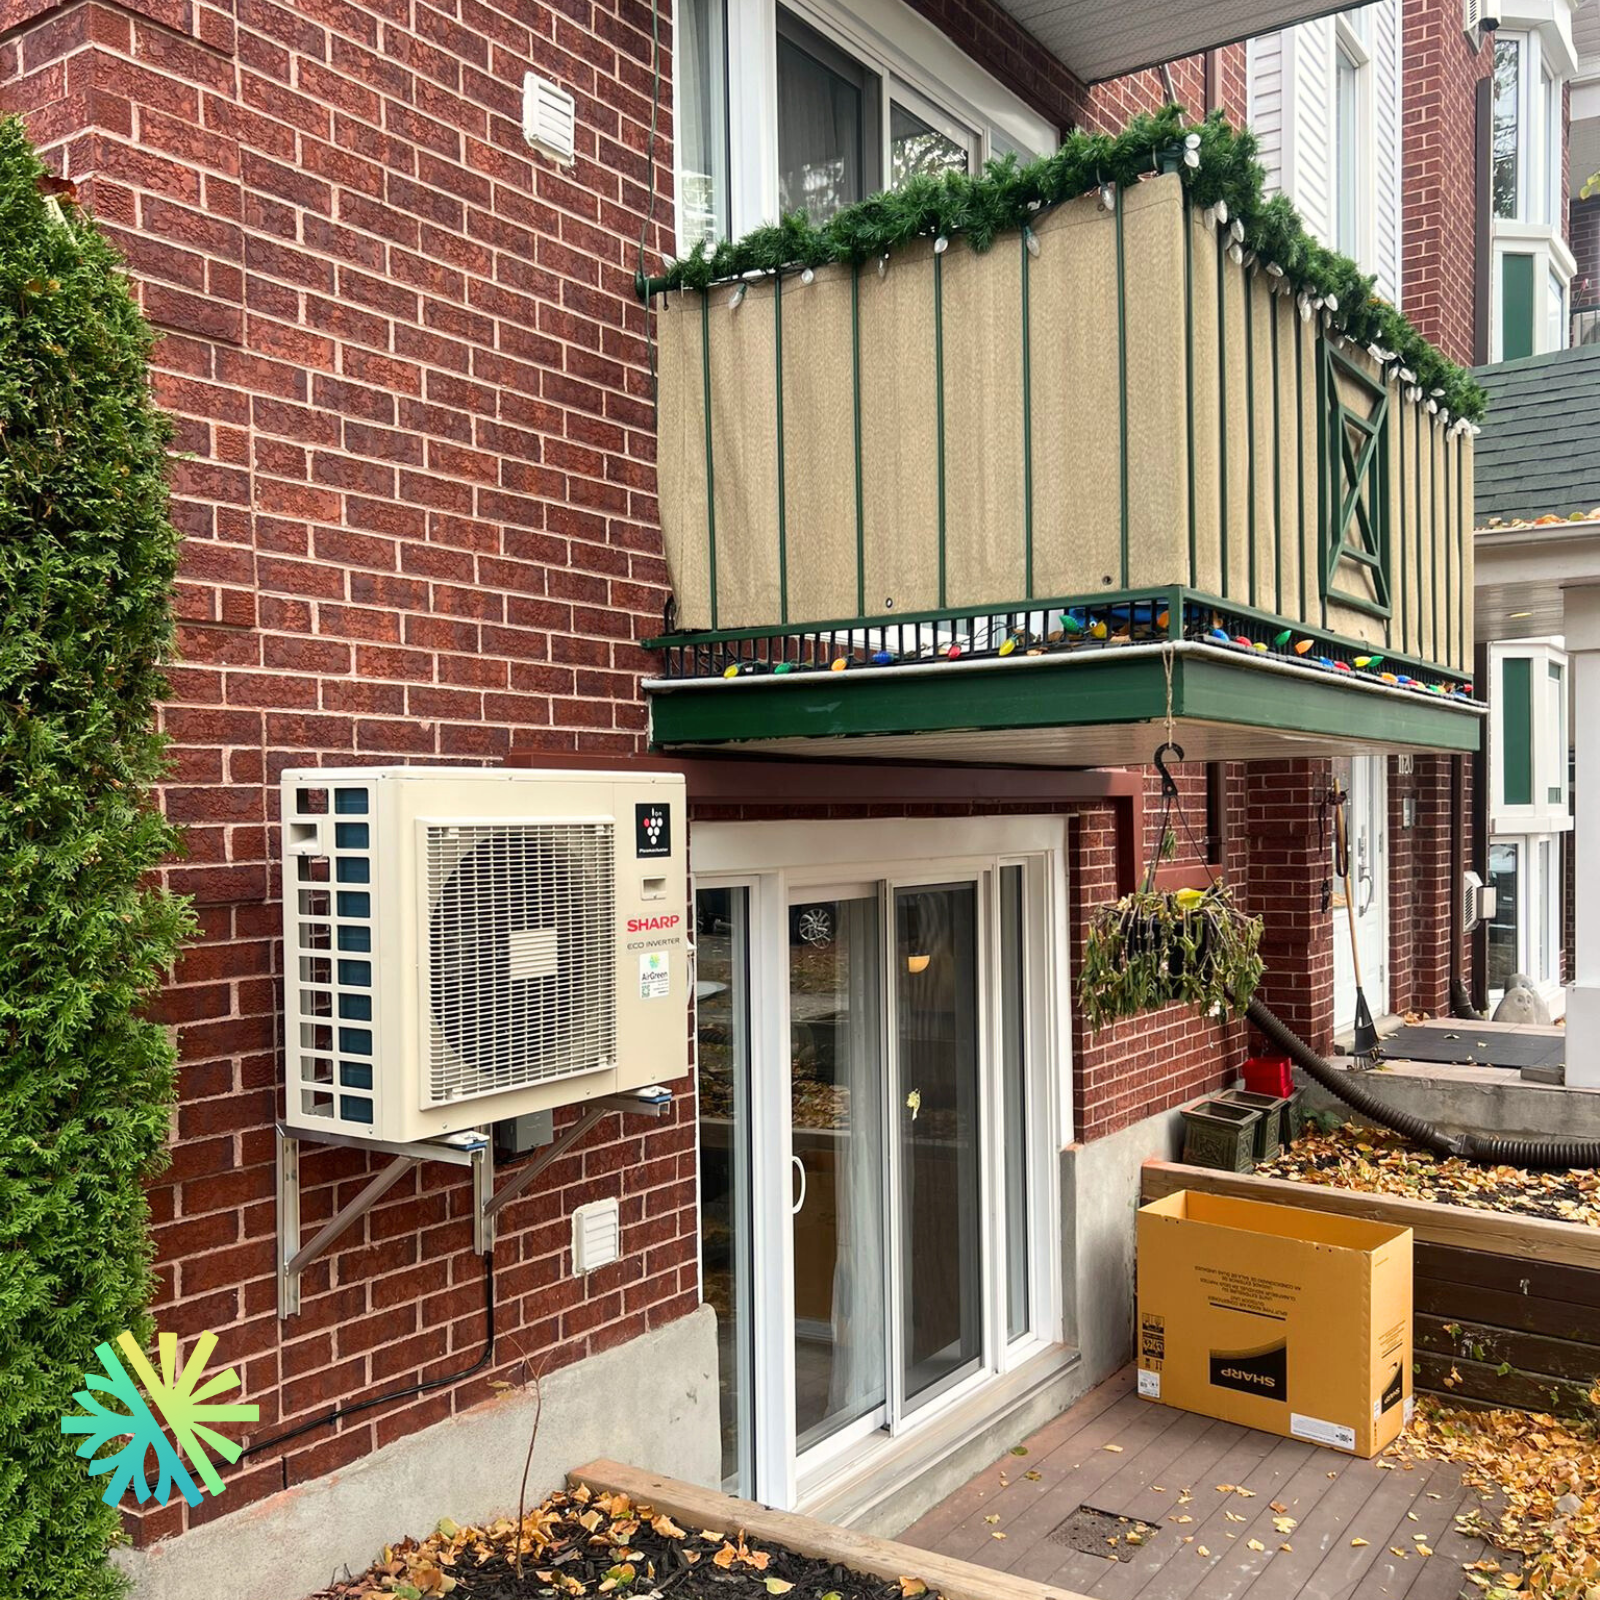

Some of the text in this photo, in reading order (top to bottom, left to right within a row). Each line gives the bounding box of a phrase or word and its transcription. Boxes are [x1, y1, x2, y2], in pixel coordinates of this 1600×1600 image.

[651, 807, 663, 817] Ion
[627, 915, 680, 932] SHARP
[627, 937, 680, 950] ECO INVERTER
[641, 971, 668, 981] AirGreen
[1221, 1368, 1275, 1388] SHARP
